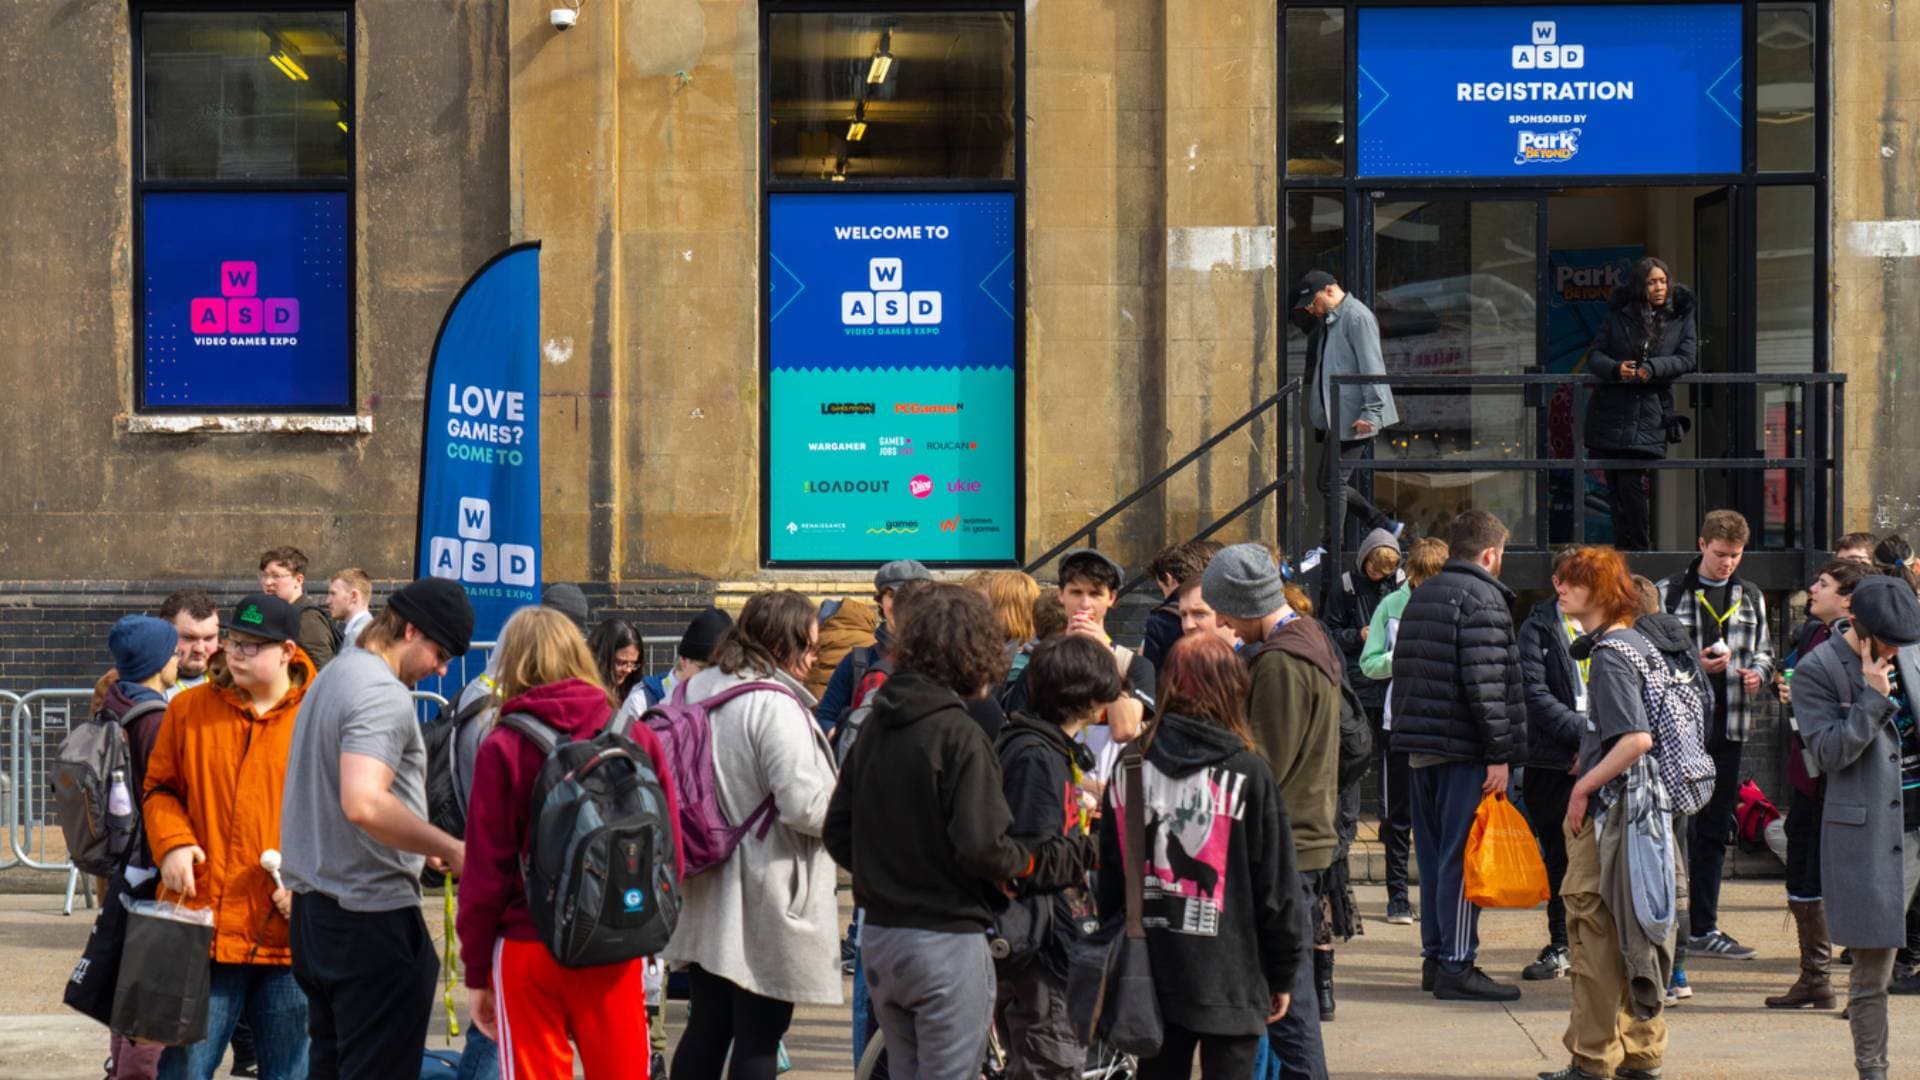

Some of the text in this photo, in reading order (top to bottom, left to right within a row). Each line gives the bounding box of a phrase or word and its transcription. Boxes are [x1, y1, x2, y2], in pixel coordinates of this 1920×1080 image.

[1536, 27, 1552, 39] W
[1457, 81, 1634, 101] REGISTRATION
[1509, 114, 1586, 124] SPONSORED BY
[1519, 130, 1577, 153] Park
[834, 225, 949, 240] WELCOME TO
[227, 271, 251, 288] W
[875, 266, 897, 282] W
[1556, 264, 1623, 292] Park
[844, 327, 940, 336] VIDEO GAMES EXPO
[194, 337, 298, 346] VIDEO GAMES EXPO
[448, 383, 525, 422] LOVE
[821, 402, 876, 415] LONDON
[447, 418, 524, 445] GAMES?
[808, 442, 866, 452] WARGAMER
[879, 436, 905, 447] GAMES
[926, 441, 969, 451] ROUCAN
[447, 442, 523, 466] COME TO
[879, 447, 897, 456] JOBS
[809, 480, 890, 493] LOADOUT
[947, 478, 982, 493] ukie
[464, 508, 485, 530] W
[886, 520, 918, 531] games
[506, 588, 533, 601] EXPO
